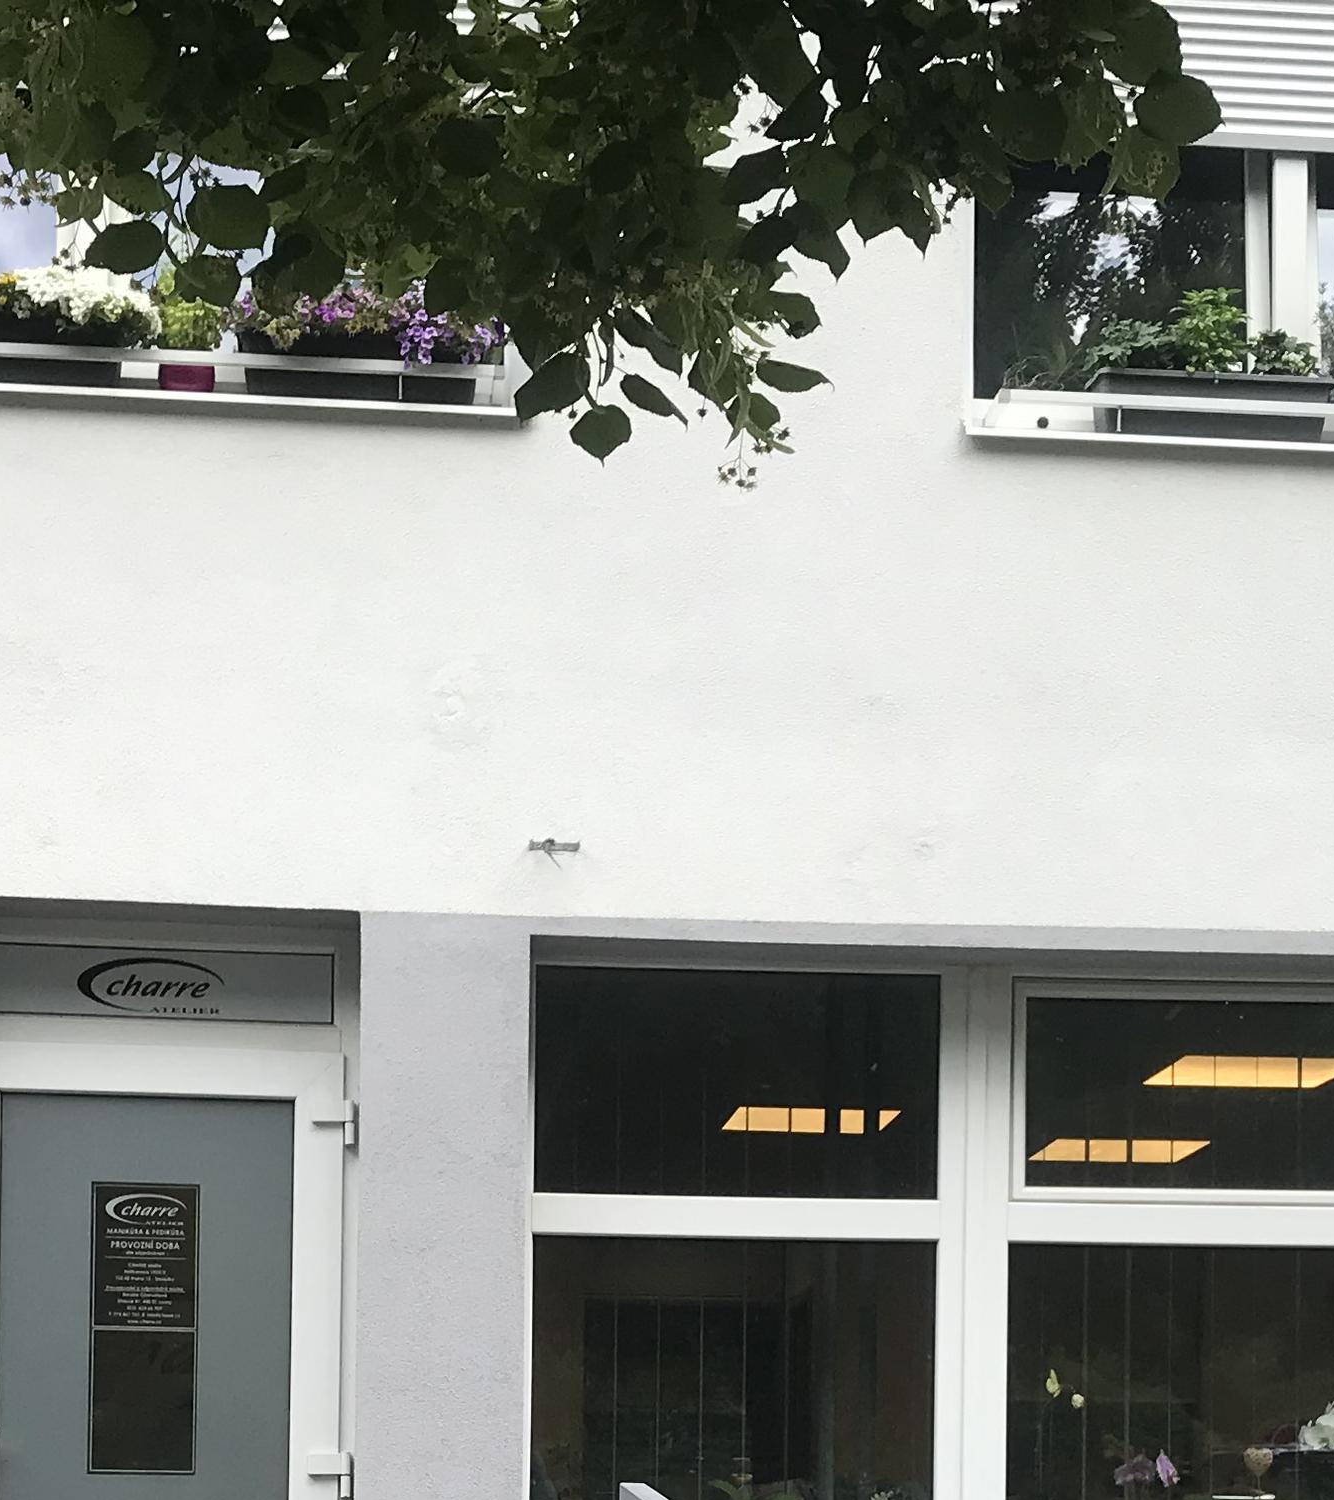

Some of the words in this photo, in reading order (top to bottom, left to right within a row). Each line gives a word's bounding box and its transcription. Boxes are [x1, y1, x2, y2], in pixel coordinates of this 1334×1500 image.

[150, 1006, 220, 1015] ATELIER
[110, 1240, 154, 1249] PROVOZNÍ
[155, 1241, 180, 1250] DOBA
